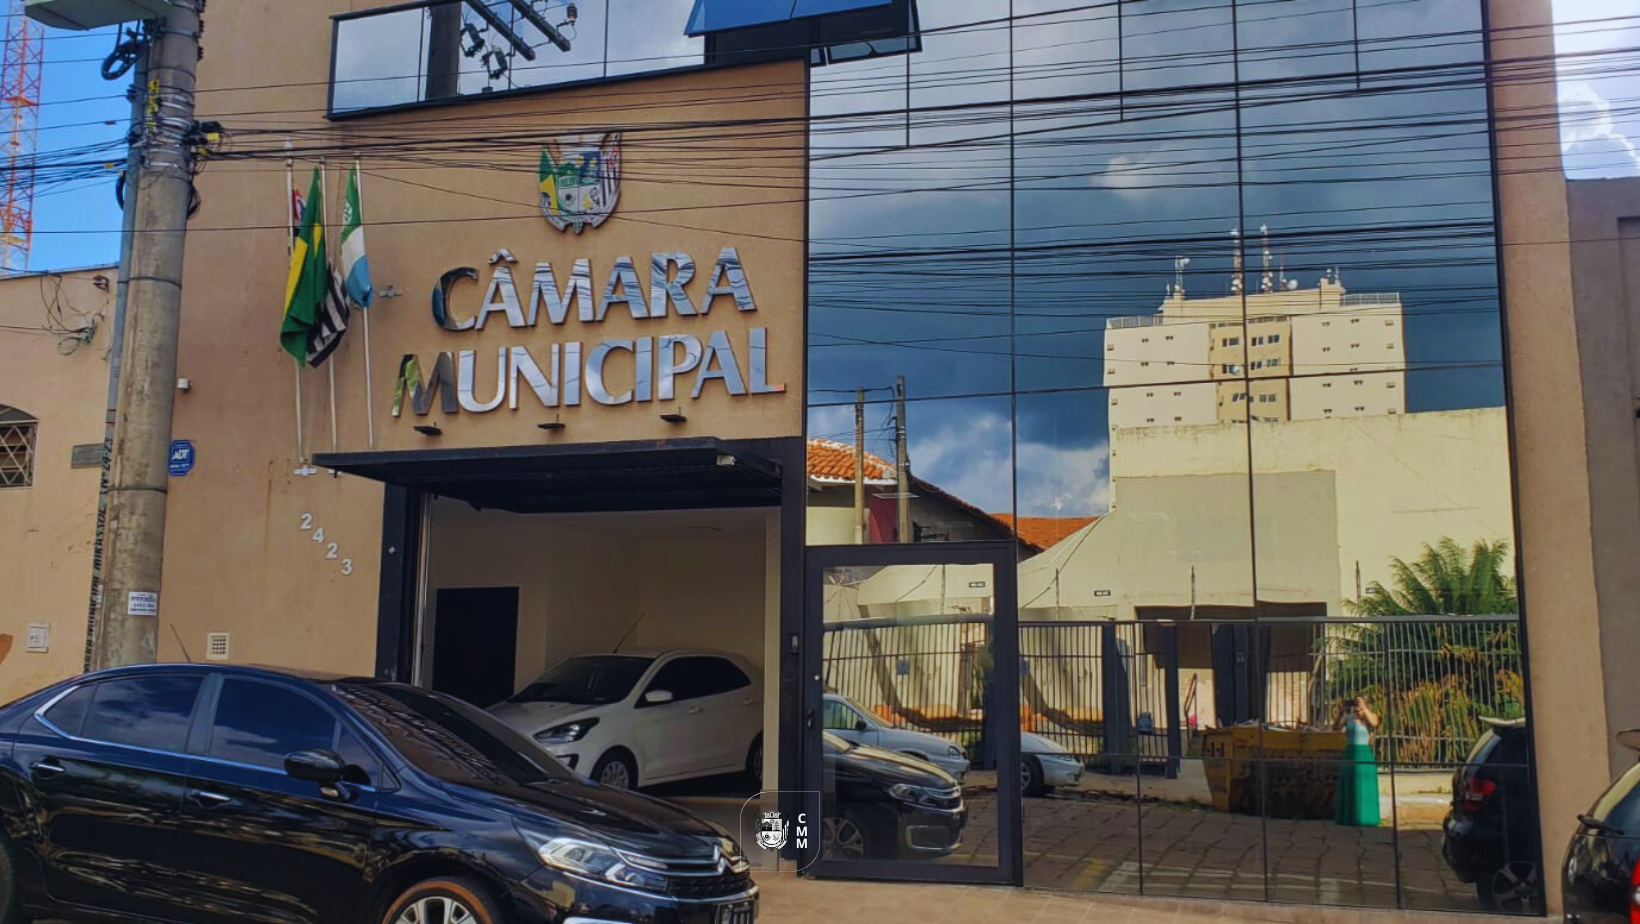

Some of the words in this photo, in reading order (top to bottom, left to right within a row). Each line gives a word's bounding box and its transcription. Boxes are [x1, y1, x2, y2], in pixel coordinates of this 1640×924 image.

[432, 247, 757, 332] CÂMARA
[391, 326, 786, 417] MUNICIPAL
[171, 448, 190, 460] ADT
